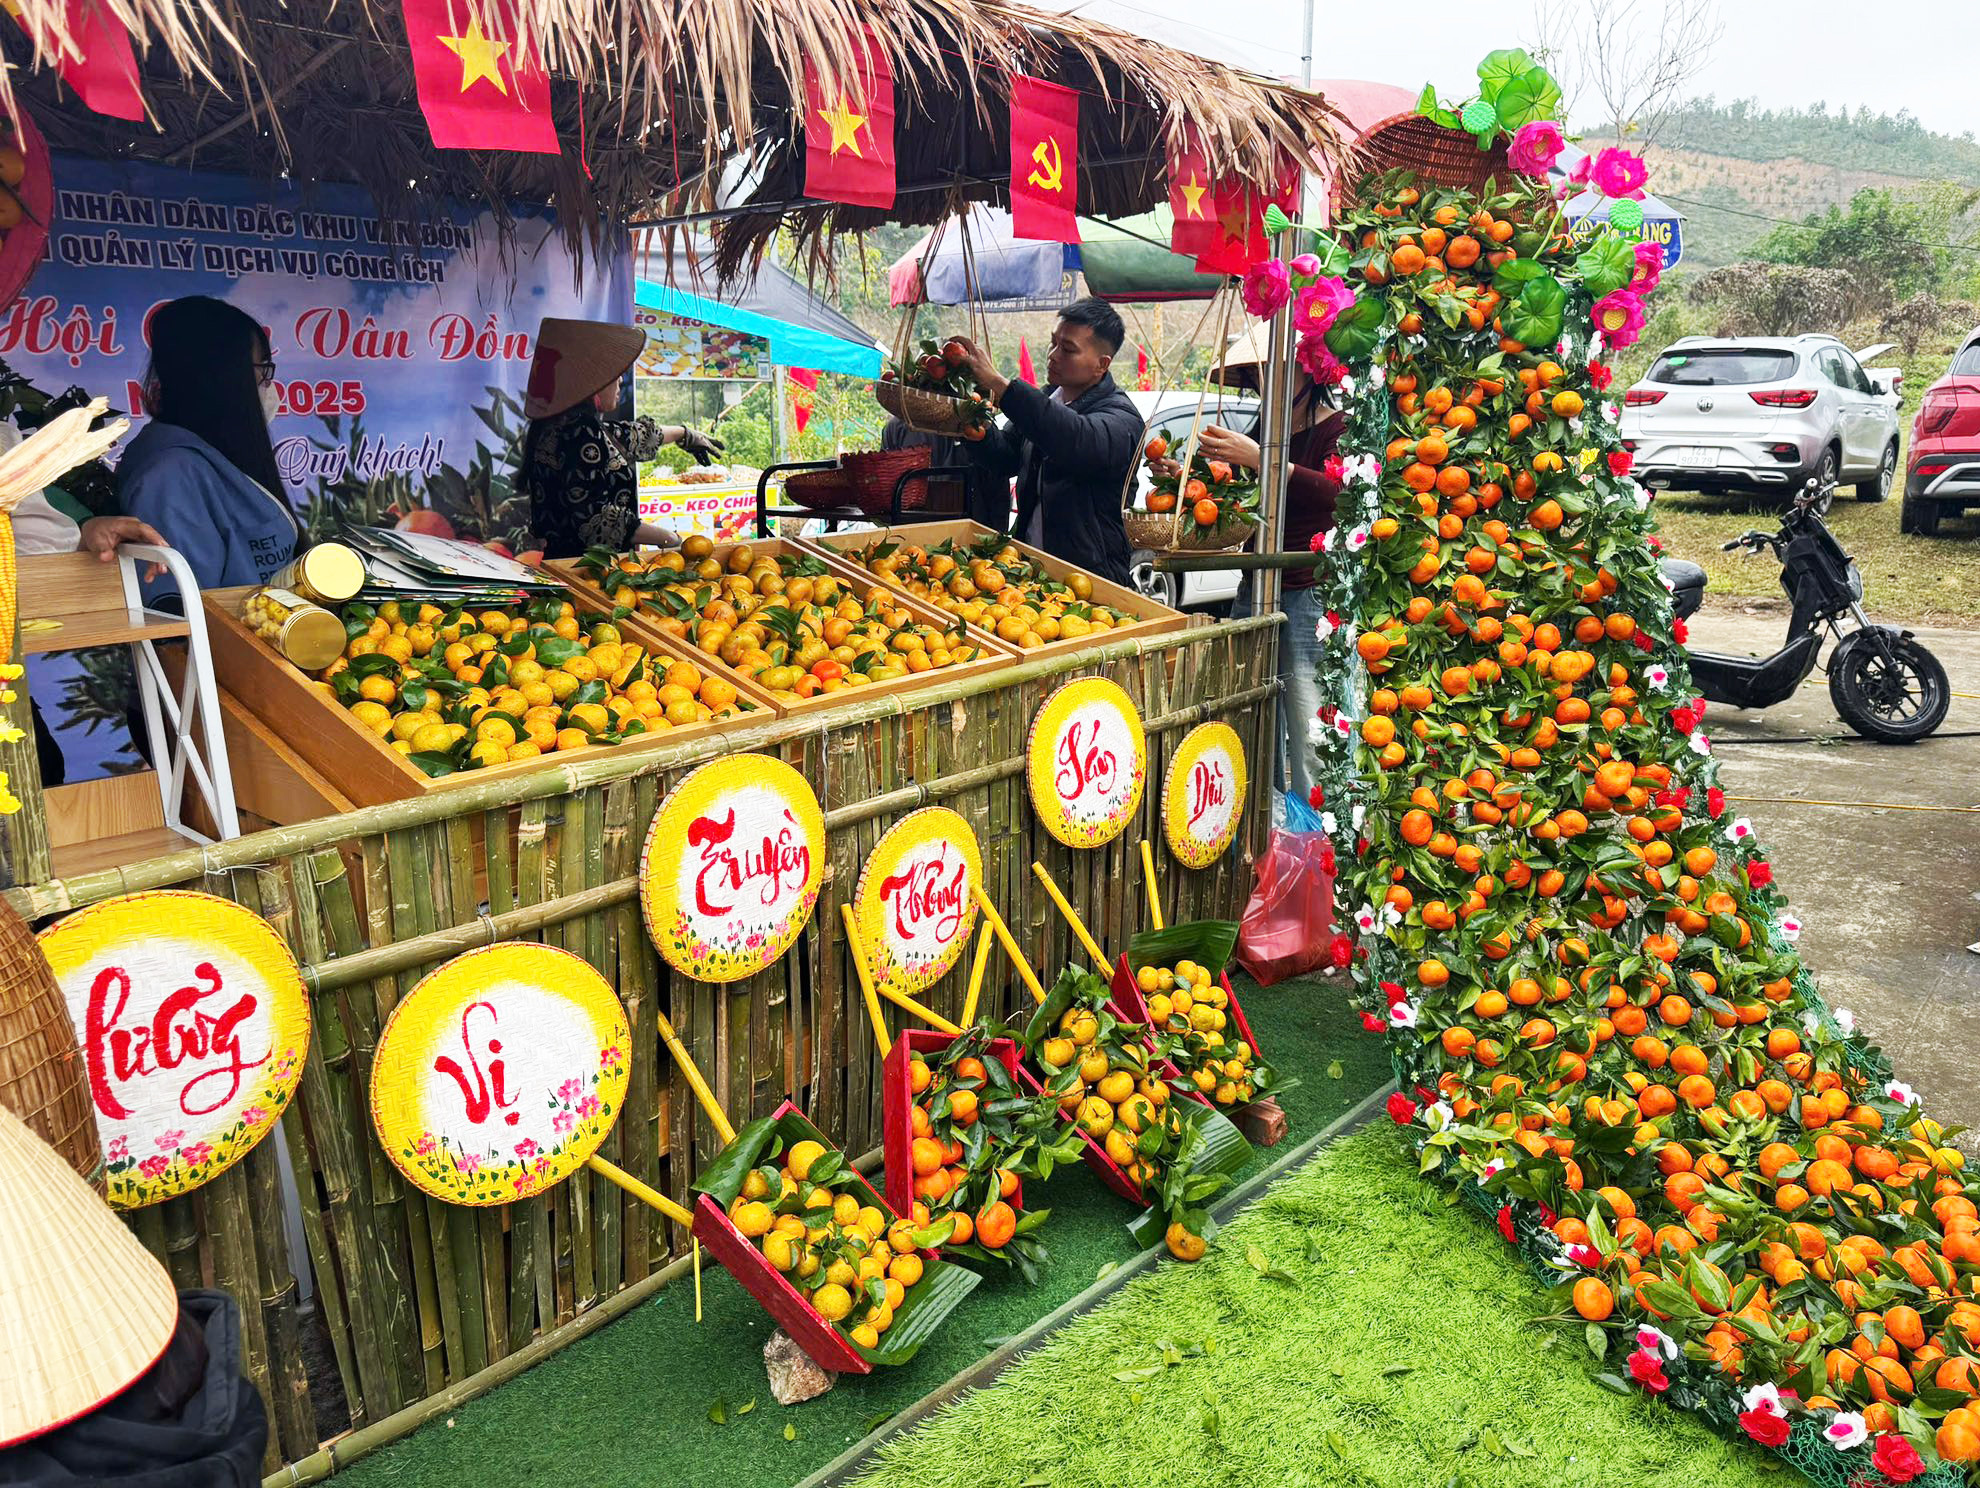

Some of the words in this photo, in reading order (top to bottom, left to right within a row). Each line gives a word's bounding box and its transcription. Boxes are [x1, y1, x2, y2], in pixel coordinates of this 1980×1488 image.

[59, 190, 157, 227] NHÂN
[161, 197, 231, 232] DÂN
[234, 203, 296, 240] ĐẶC
[301, 212, 358, 241] KHU
[420, 216, 472, 249] ĐỒN
[58, 229, 153, 268] QUẢN
[157, 237, 198, 271] LÝ
[202, 243, 276, 278] DỊCH
[280, 250, 319, 281] VỤ
[324, 250, 398, 281] CÔNG
[402, 252, 445, 283] ÍCH
[0, 295, 124, 368] Hội
[294, 307, 415, 360] Vân
[428, 312, 535, 361] Đồn
[634, 309, 657, 325] ẺO
[273, 434, 350, 487] Quý
[355, 432, 444, 480] khách!
[686, 499, 719, 514] KẸO
[248, 535, 277, 551] RET
[1056, 719, 1117, 801] Sán
[688, 807, 810, 917] Truyền
[880, 840, 968, 944] Thống
[434, 1001, 522, 1127] Vị
